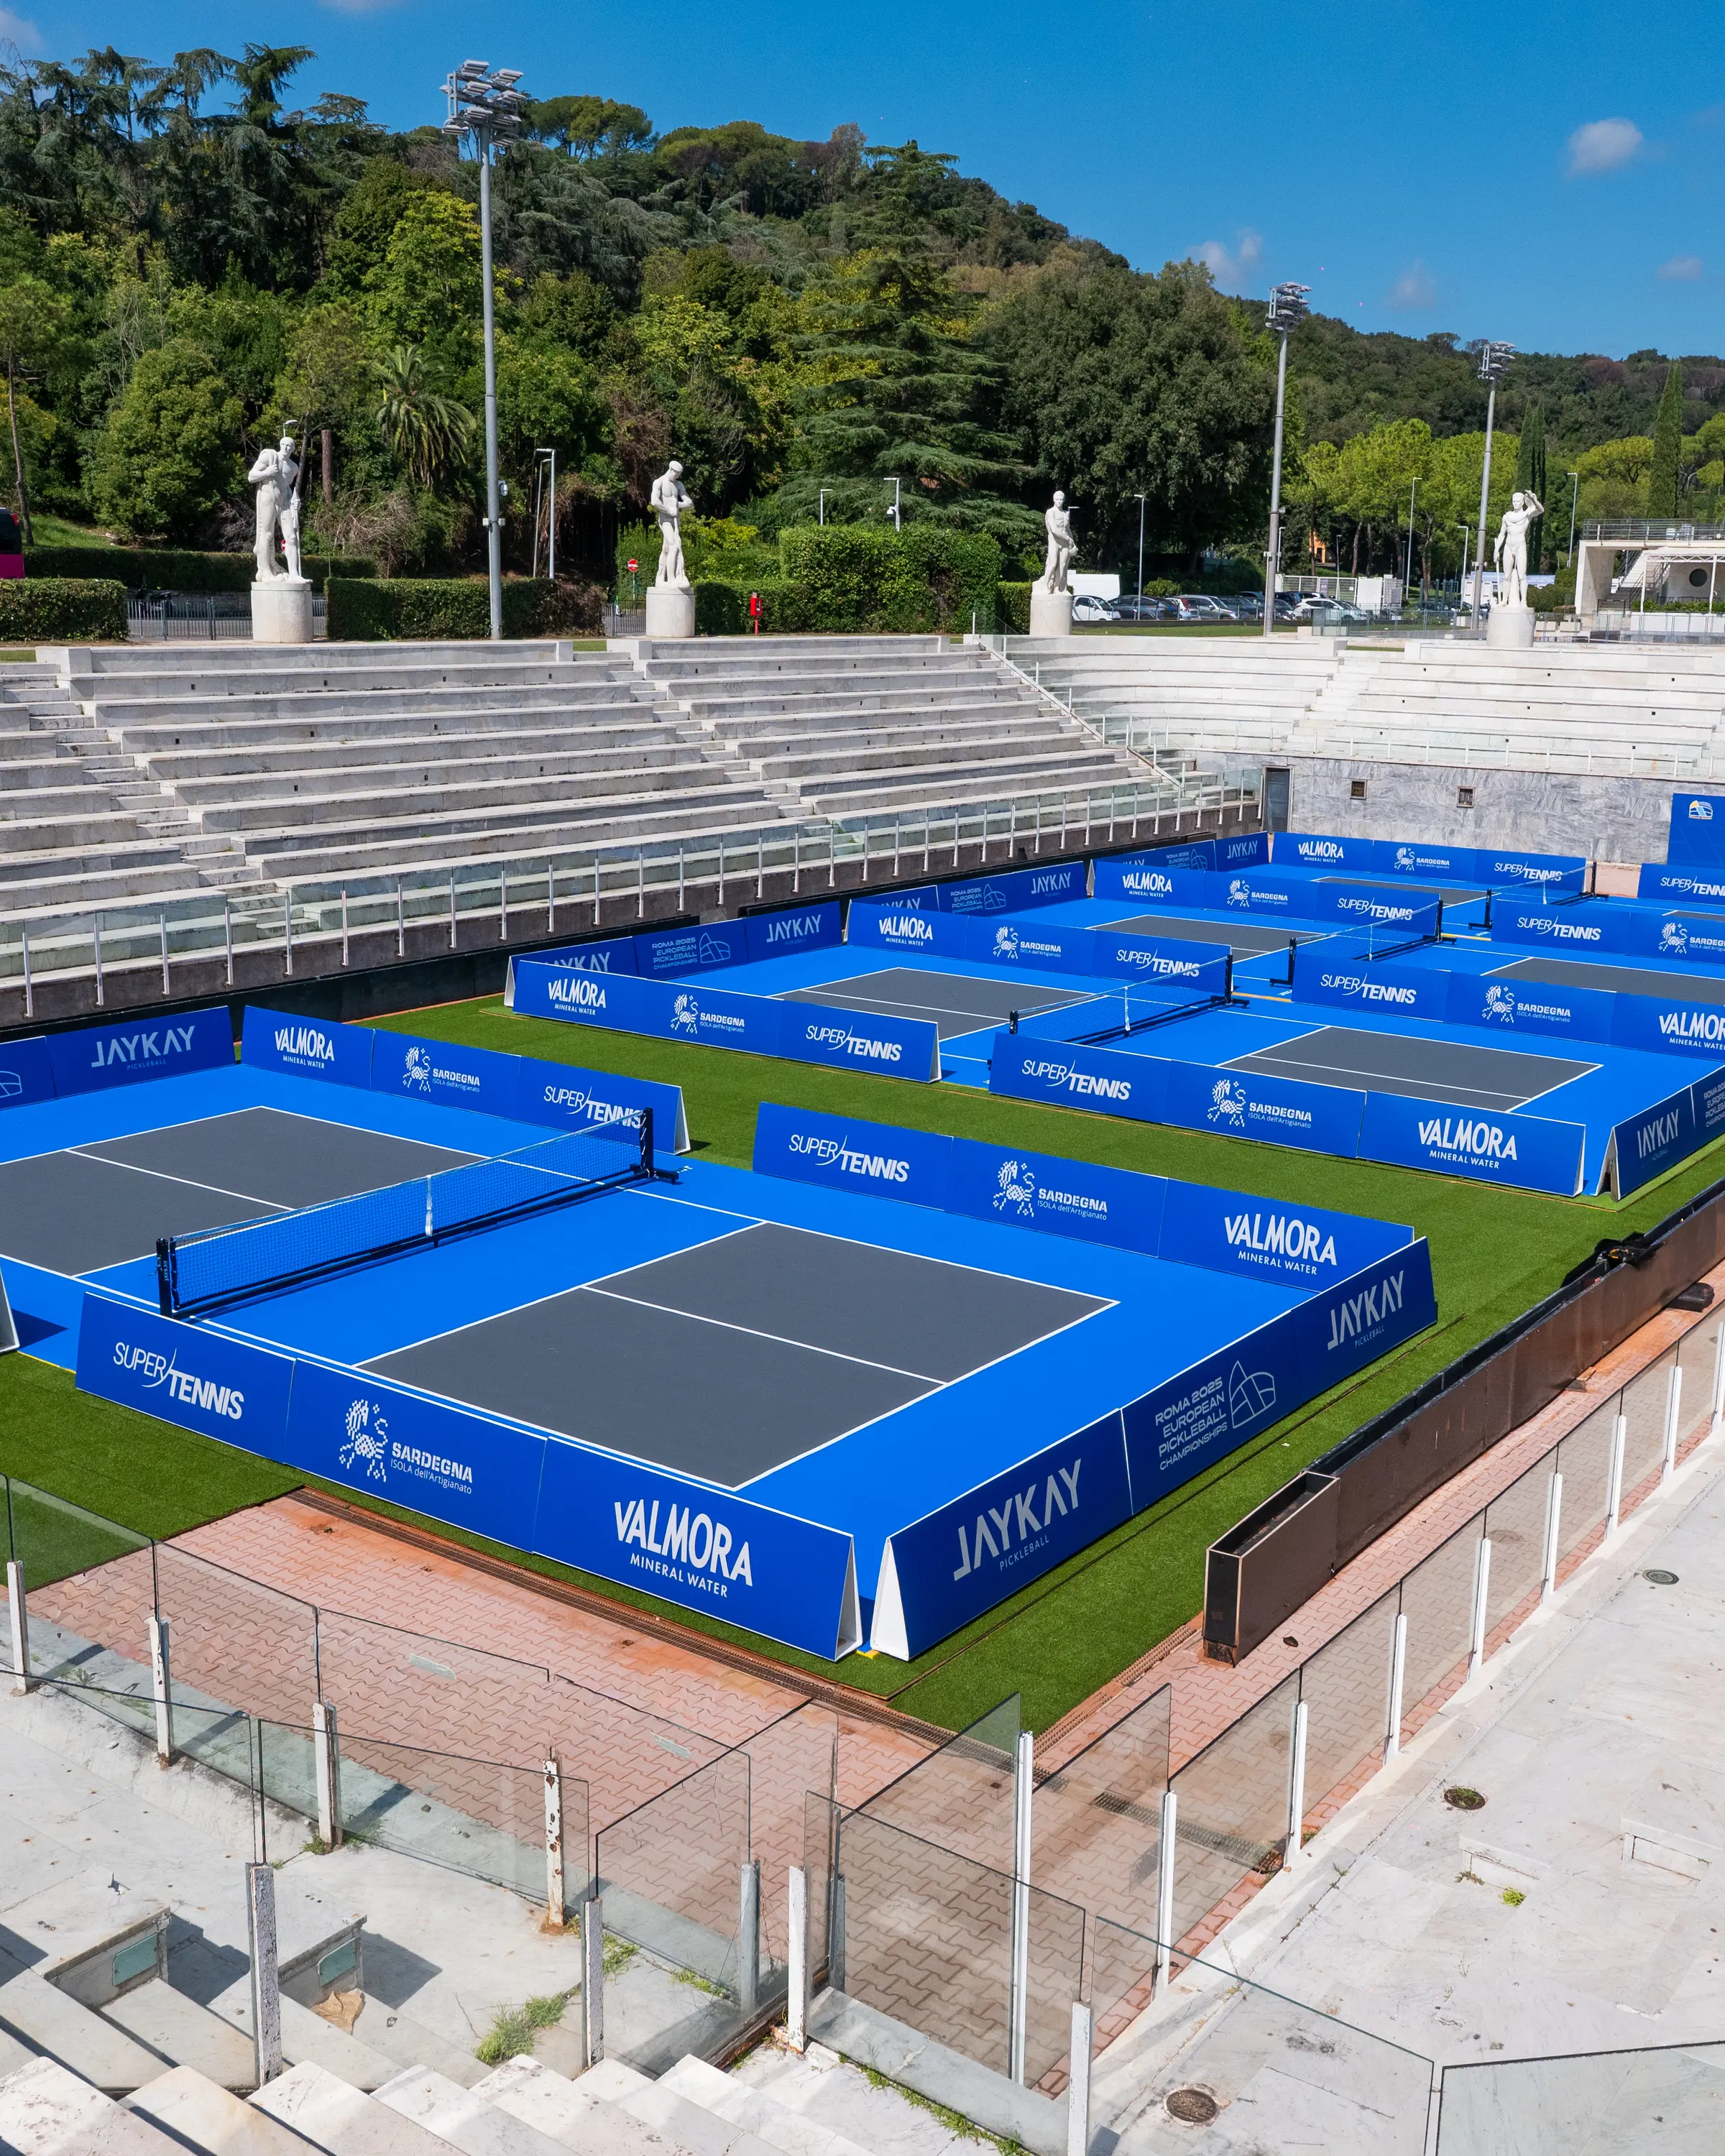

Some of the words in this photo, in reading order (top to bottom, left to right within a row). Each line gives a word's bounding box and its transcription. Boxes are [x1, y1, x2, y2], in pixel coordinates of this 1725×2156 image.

[1227, 840, 1258, 859] JAYKAY
[1298, 840, 1344, 858] VALMORA
[1416, 857, 1450, 866] SARDEGNA
[1494, 862, 1522, 874] SUPER
[1031, 872, 1071, 894] JAYKAY
[1122, 872, 1172, 893] VALMORA
[1660, 877, 1692, 888] SUPER
[952, 898, 983, 908] PICKLEBALL
[954, 893, 982, 903] EUROPEAN
[1251, 892, 1288, 901] SARDEGNA
[1338, 898, 1369, 911] SUPER
[1370, 905, 1414, 921] TENNIS
[766, 914, 822, 943] JAYKAY
[879, 916, 933, 940] VALMORA
[1517, 917, 1552, 931] SUPER
[1553, 923, 1602, 941] TENNIS
[652, 941, 674, 949] ROMA
[675, 936, 696, 945] 2025
[656, 944, 696, 956] EUROPEAN
[1020, 941, 1062, 953] SARDEGNA
[1689, 936, 1725, 946] SARDEG
[653, 951, 697, 963] PICKLEBALL
[653, 958, 697, 969] CHAMPIONSHIPS
[1116, 949, 1151, 964] SUPER
[548, 978, 607, 1008] VALMORA
[1320, 974, 1361, 990] SUPER
[1361, 983, 1417, 1004] TENNIS
[554, 1003, 577, 1013] MINERAL
[1517, 1003, 1571, 1017] SARDEGNA
[699, 1013, 745, 1027] SARDEGNA
[91, 1025, 196, 1068] JAYKAY
[275, 1027, 335, 1061] VALMORA
[806, 1025, 846, 1044] SUPER
[847, 1036, 902, 1061] TENNIS
[1669, 1037, 1702, 1048] MINERAL
[1703, 1041, 1725, 1050] WATE
[126, 1058, 166, 1070] PICKLEBALL
[282, 1055, 306, 1066] MINERAL
[307, 1059, 325, 1069] WATER
[433, 1068, 480, 1086] SARDEGNA
[1021, 1059, 1067, 1080] SUPER
[1068, 1072, 1131, 1100] TENNIS
[543, 1086, 584, 1107] SUPER
[586, 1100, 643, 1129] TENNIS
[1249, 1102, 1312, 1122] SARDEGNA
[1248, 1112, 1266, 1121] ISOLA
[1266, 1115, 1312, 1129] dell'Artigianato
[1418, 1118, 1517, 1161] VALMORA
[788, 1134, 839, 1159] SUPER
[840, 1150, 910, 1182] TENNIS
[1429, 1150, 1468, 1164] MINERAL
[1471, 1157, 1499, 1169] WATER
[1037, 1199, 1057, 1210] ISOLA
[1057, 1204, 1107, 1221] dell'Artigianato
[1038, 1188, 1108, 1212] SARDEGNA
[1224, 1213, 1338, 1266] VALMORA
[1238, 1250, 1282, 1268] MINERAL
[1284, 1260, 1317, 1275] WATER
[1327, 1270, 1404, 1350] JAYKAY
[1354, 1325, 1385, 1348] PICKLEBALL
[113, 1342, 167, 1380] SUPER
[168, 1368, 244, 1420] TENNIS
[1155, 1396, 1190, 1426] ROMA
[1192, 1376, 1223, 1404] 2025
[1163, 1391, 1225, 1438] EUROPEAN
[1159, 1409, 1226, 1457] PICKLEBALL
[1159, 1422, 1228, 1470] CHAMPIONSHIPS
[392, 1442, 473, 1483] SARDEGNA
[390, 1458, 413, 1474] ISOLA
[414, 1467, 472, 1495] dell'Artigianato
[953, 1458, 1081, 1581] JAYKAY
[614, 1499, 753, 1587] VALMORA
[999, 1534, 1049, 1571] PICKLEBALL
[630, 1552, 684, 1583] MINERAL
[687, 1572, 727, 1598] WATER
